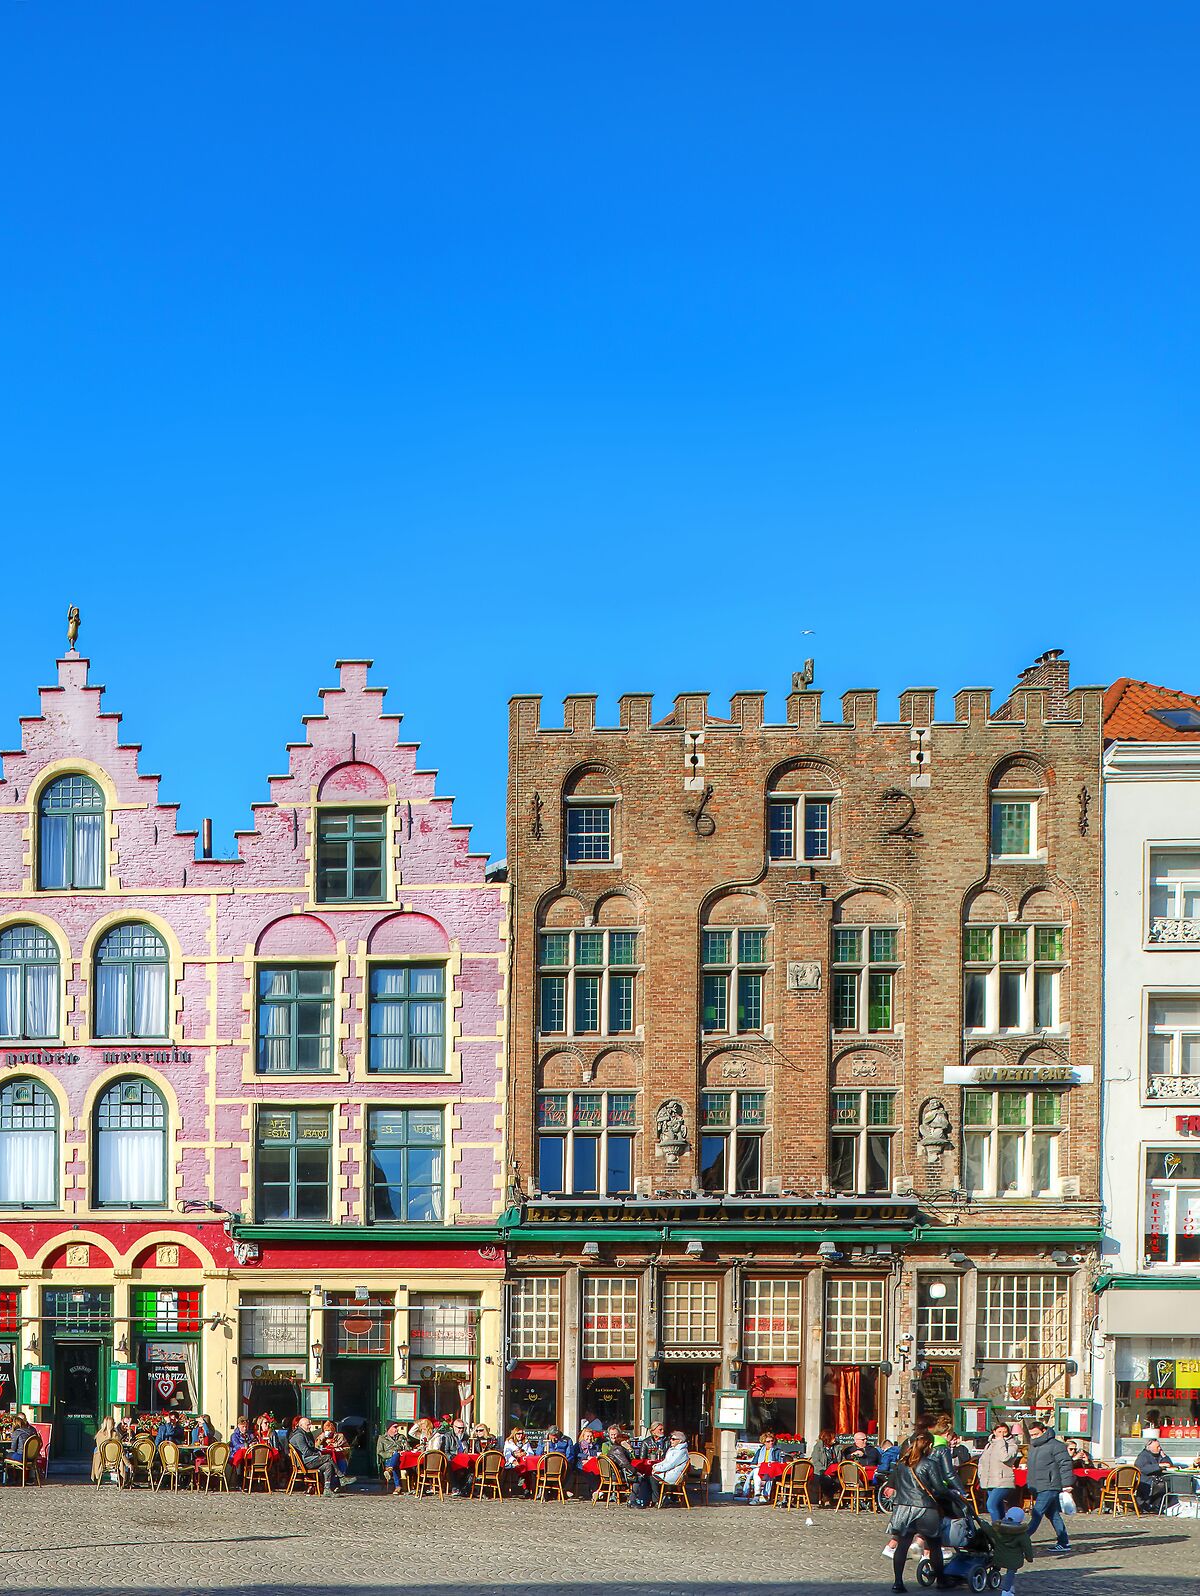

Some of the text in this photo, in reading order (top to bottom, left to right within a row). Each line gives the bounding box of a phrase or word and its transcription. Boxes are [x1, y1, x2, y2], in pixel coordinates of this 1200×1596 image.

[974, 1067, 994, 1081] AU
[996, 1066, 1037, 1082] PETIT
[526, 1207, 682, 1222] RESTAURANT
[697, 1207, 729, 1221] LA
[170, 1373, 188, 1381] PIZZA
[1135, 1388, 1199, 1400] FRITERIE
